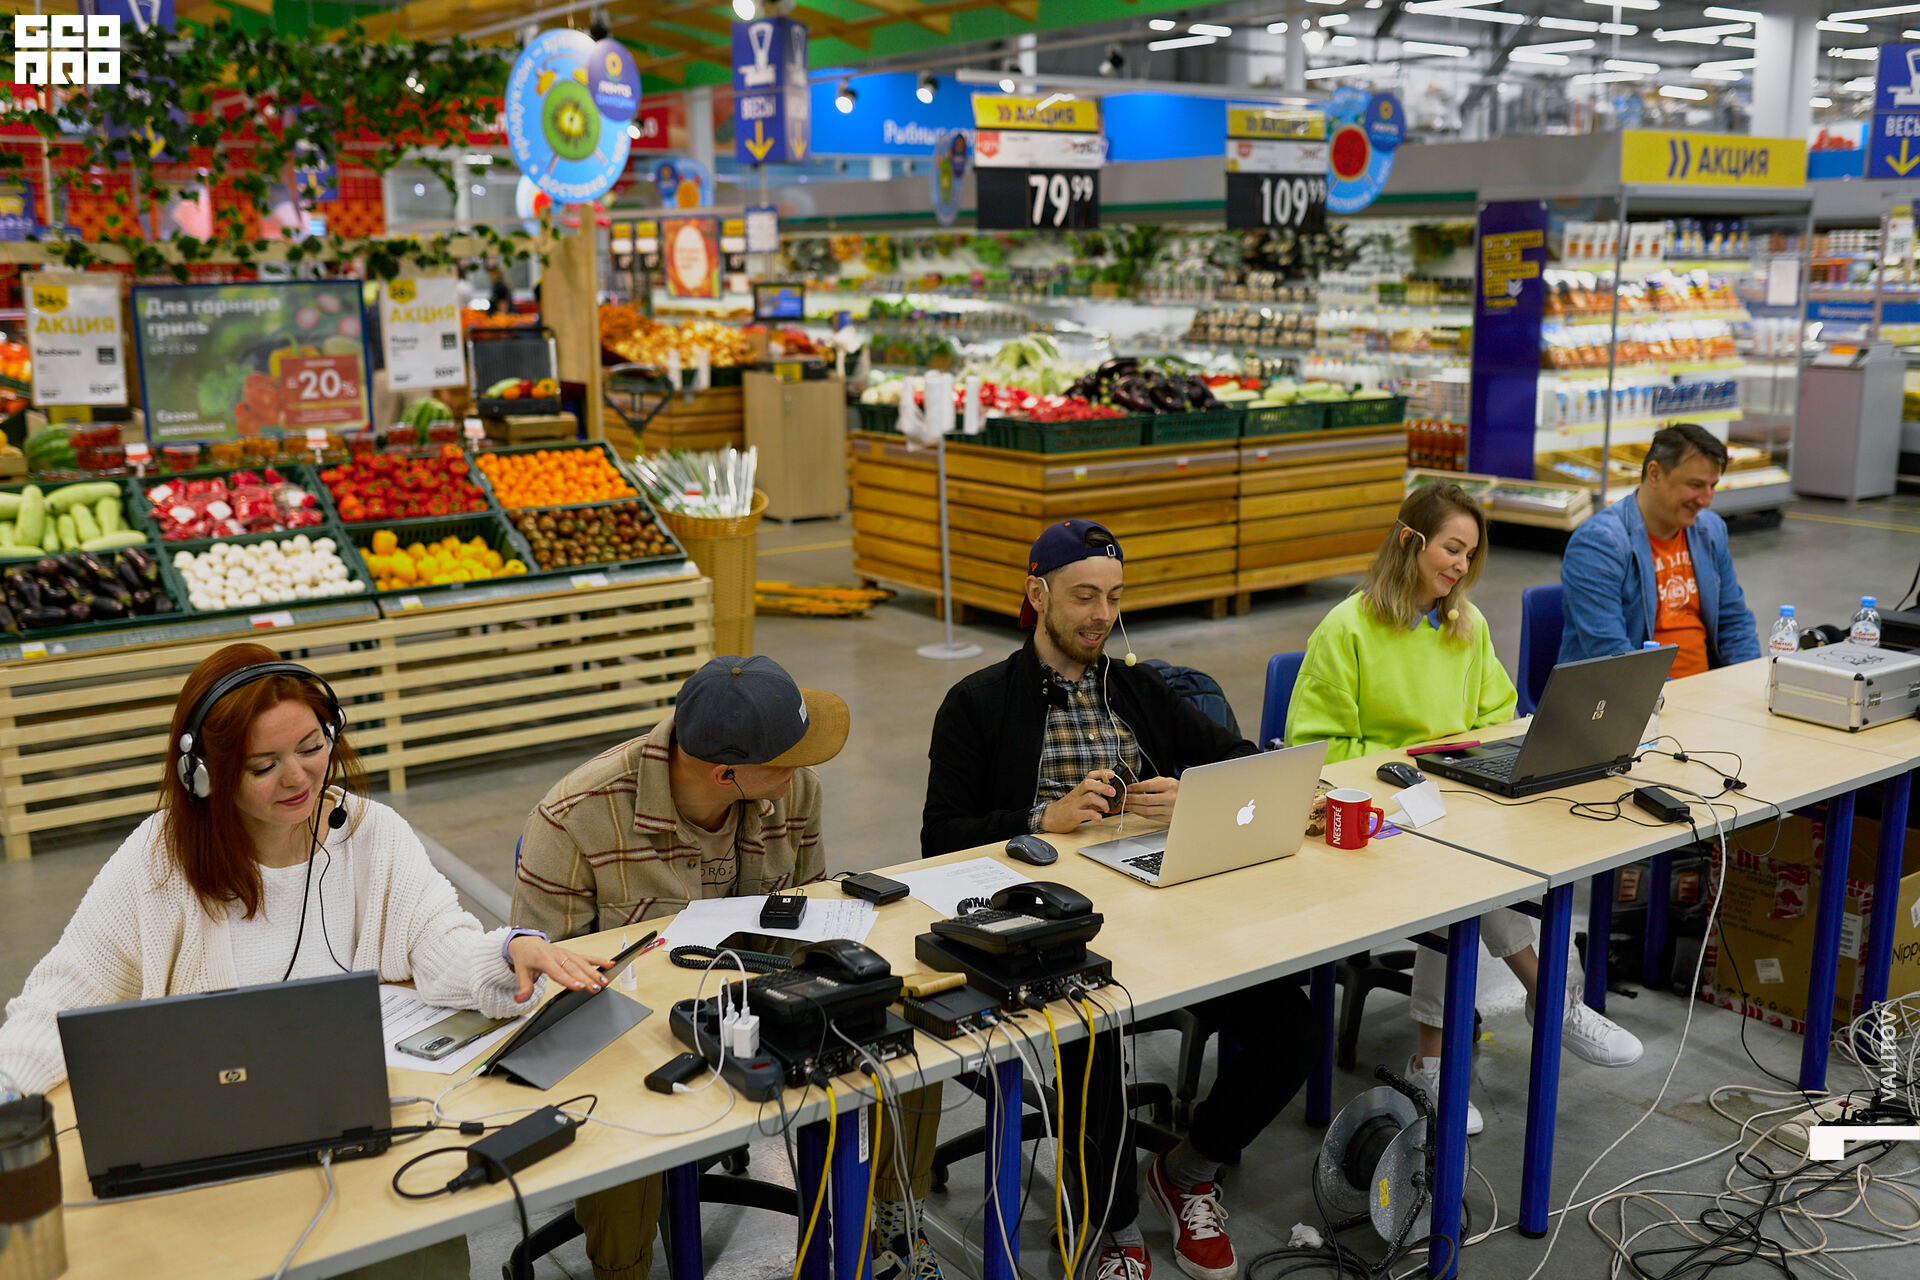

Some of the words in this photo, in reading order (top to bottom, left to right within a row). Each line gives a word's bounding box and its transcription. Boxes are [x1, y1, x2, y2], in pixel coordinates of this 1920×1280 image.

[1697, 147, 1769, 180] АКЦИЯ
[1028, 173, 1070, 227] 79
[1261, 178, 1309, 226] 109
[144, 297, 188, 319] Для
[192, 297, 282, 319] гарнира
[390, 304, 456, 325] АКЦИЯ
[35, 316, 116, 336] АКЦИЯ
[147, 321, 209, 341] гриль
[1332, 805, 1342, 845] NESCAFÉ
